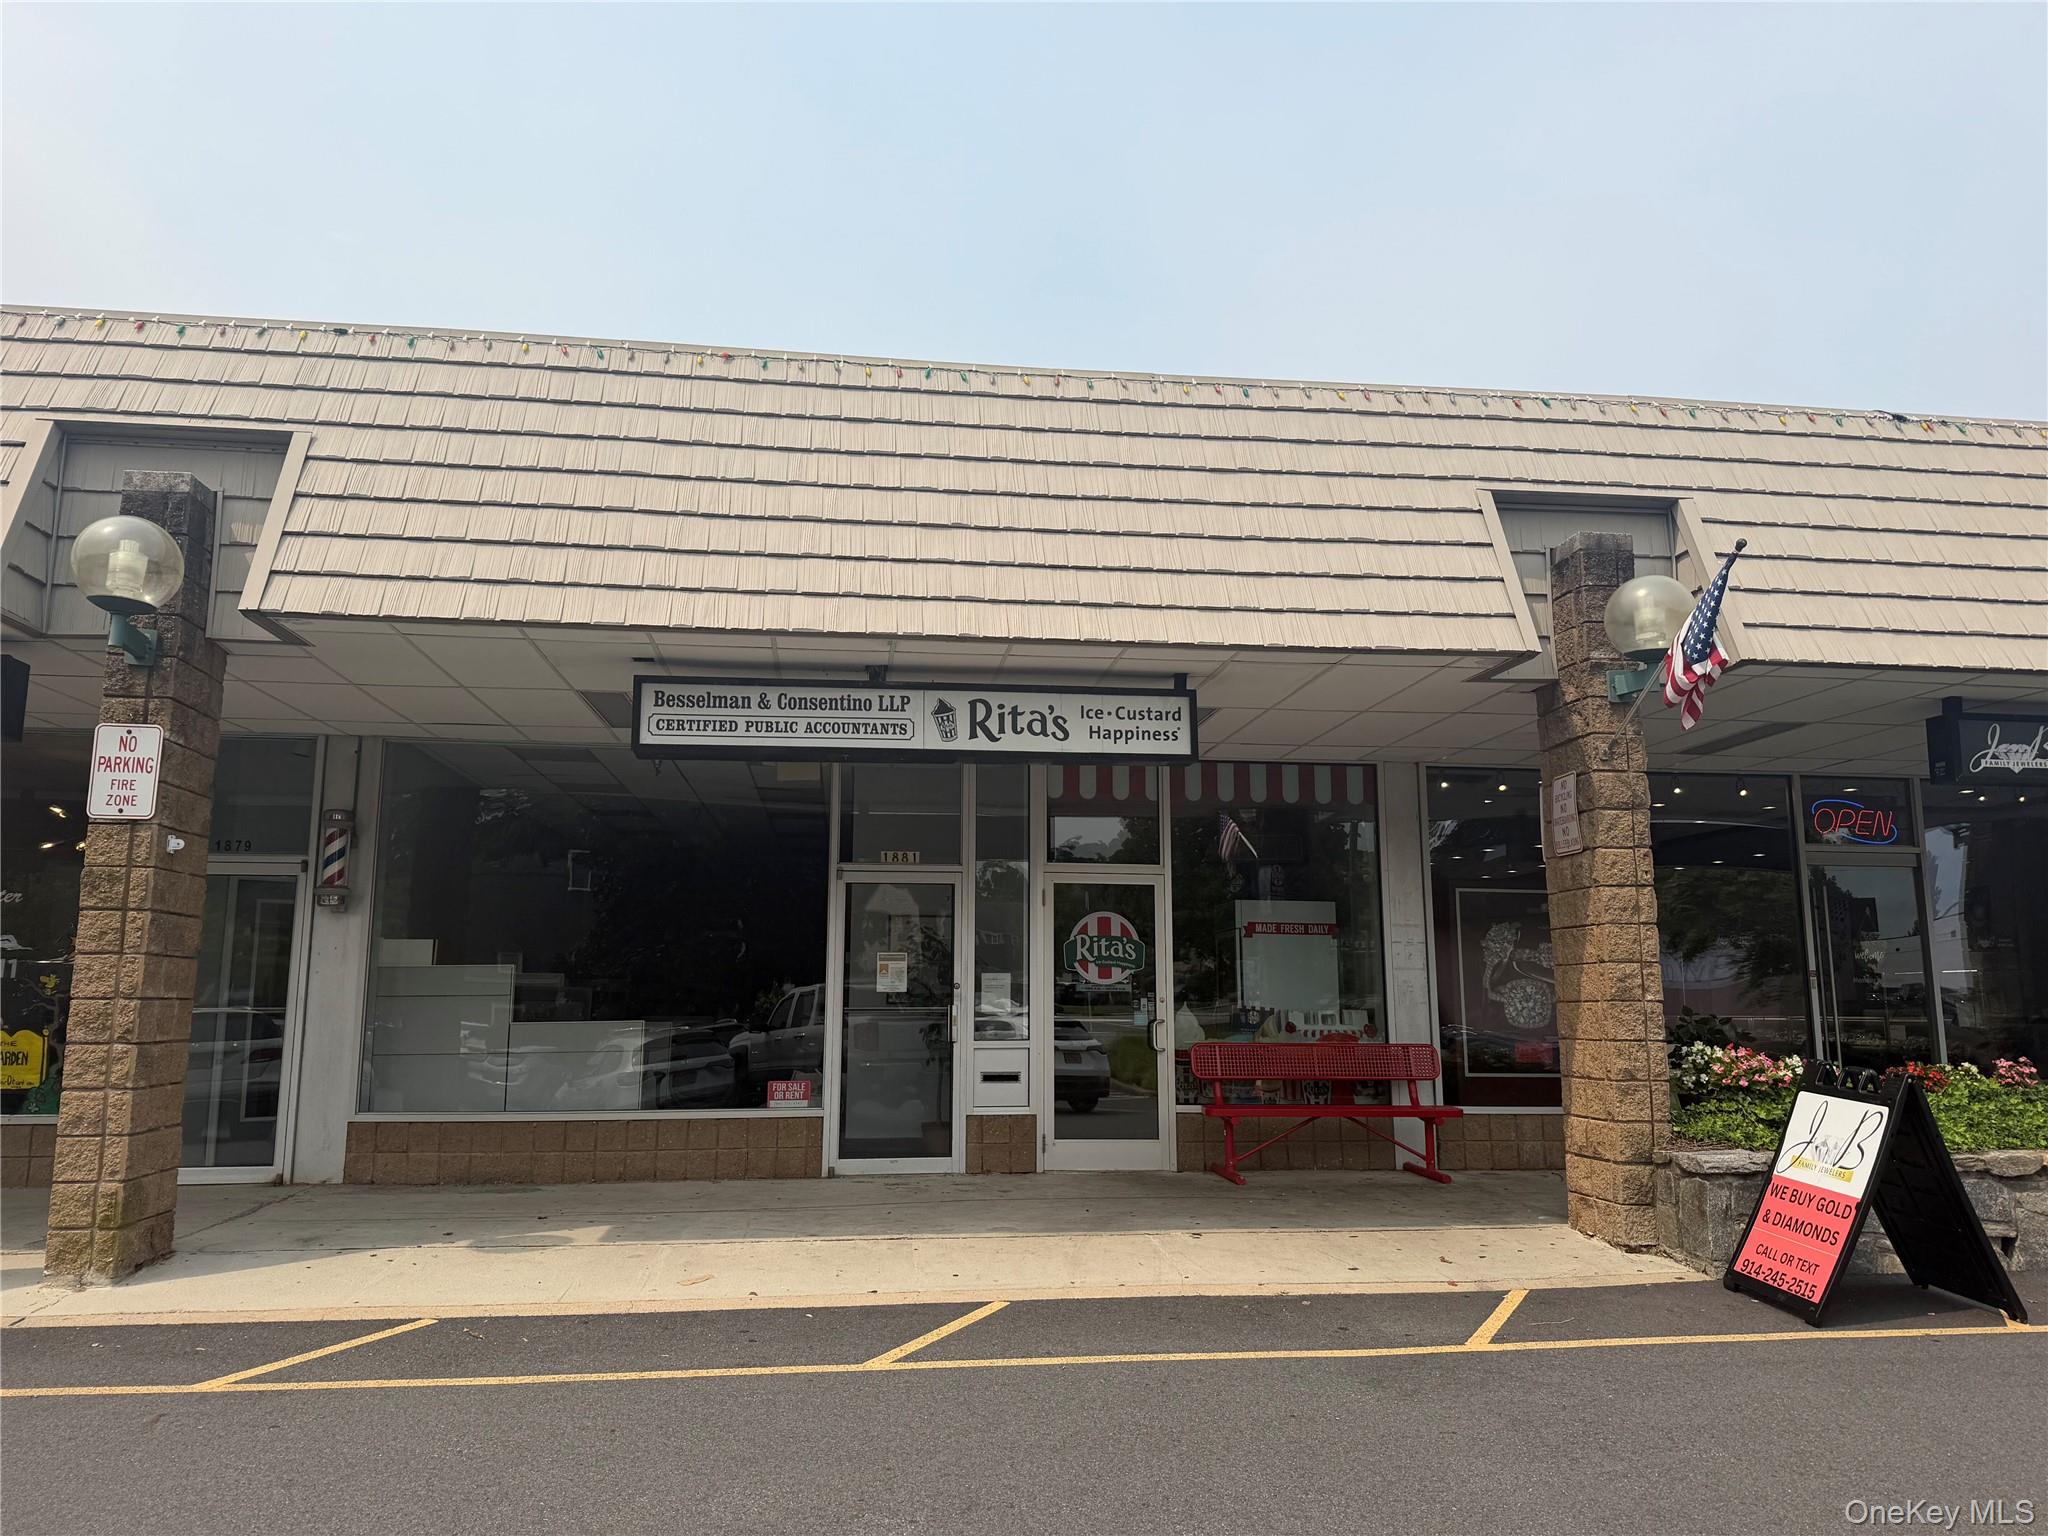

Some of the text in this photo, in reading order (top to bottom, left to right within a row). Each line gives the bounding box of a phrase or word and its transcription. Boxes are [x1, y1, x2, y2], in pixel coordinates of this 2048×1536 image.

[653, 690, 911, 712] Besselman & Consentino LLP
[655, 718, 908, 736] CERTIFIED PUBLIC ACCOUNTANTS
[968, 698, 1070, 743] Rita's
[118, 735, 138, 753] NO
[1089, 725, 1180, 745] Happiness
[97, 755, 155, 774] PARKING
[110, 778, 137, 791] FIRE
[105, 794, 138, 807] ZONE
[1814, 808, 1893, 837] OPEN
[215, 840, 252, 852] 1879
[883, 852, 917, 863] 1881
[1255, 923, 1329, 934] MADE FRESH DAILY
[1075, 934, 1137, 961] Rita's
[772, 1082, 806, 1091] FOR SALE
[773, 1091, 804, 1100] OR RENT
[1797, 1160, 1847, 1179] FAMILY JEWELERS
[1769, 1182, 1853, 1220] WE BUY GOLD
[1762, 1208, 1840, 1246] & DIAMONDS
[1755, 1243, 1820, 1276] CALL OR TEXT
[1740, 1258, 1818, 1300] 914-245-2515
